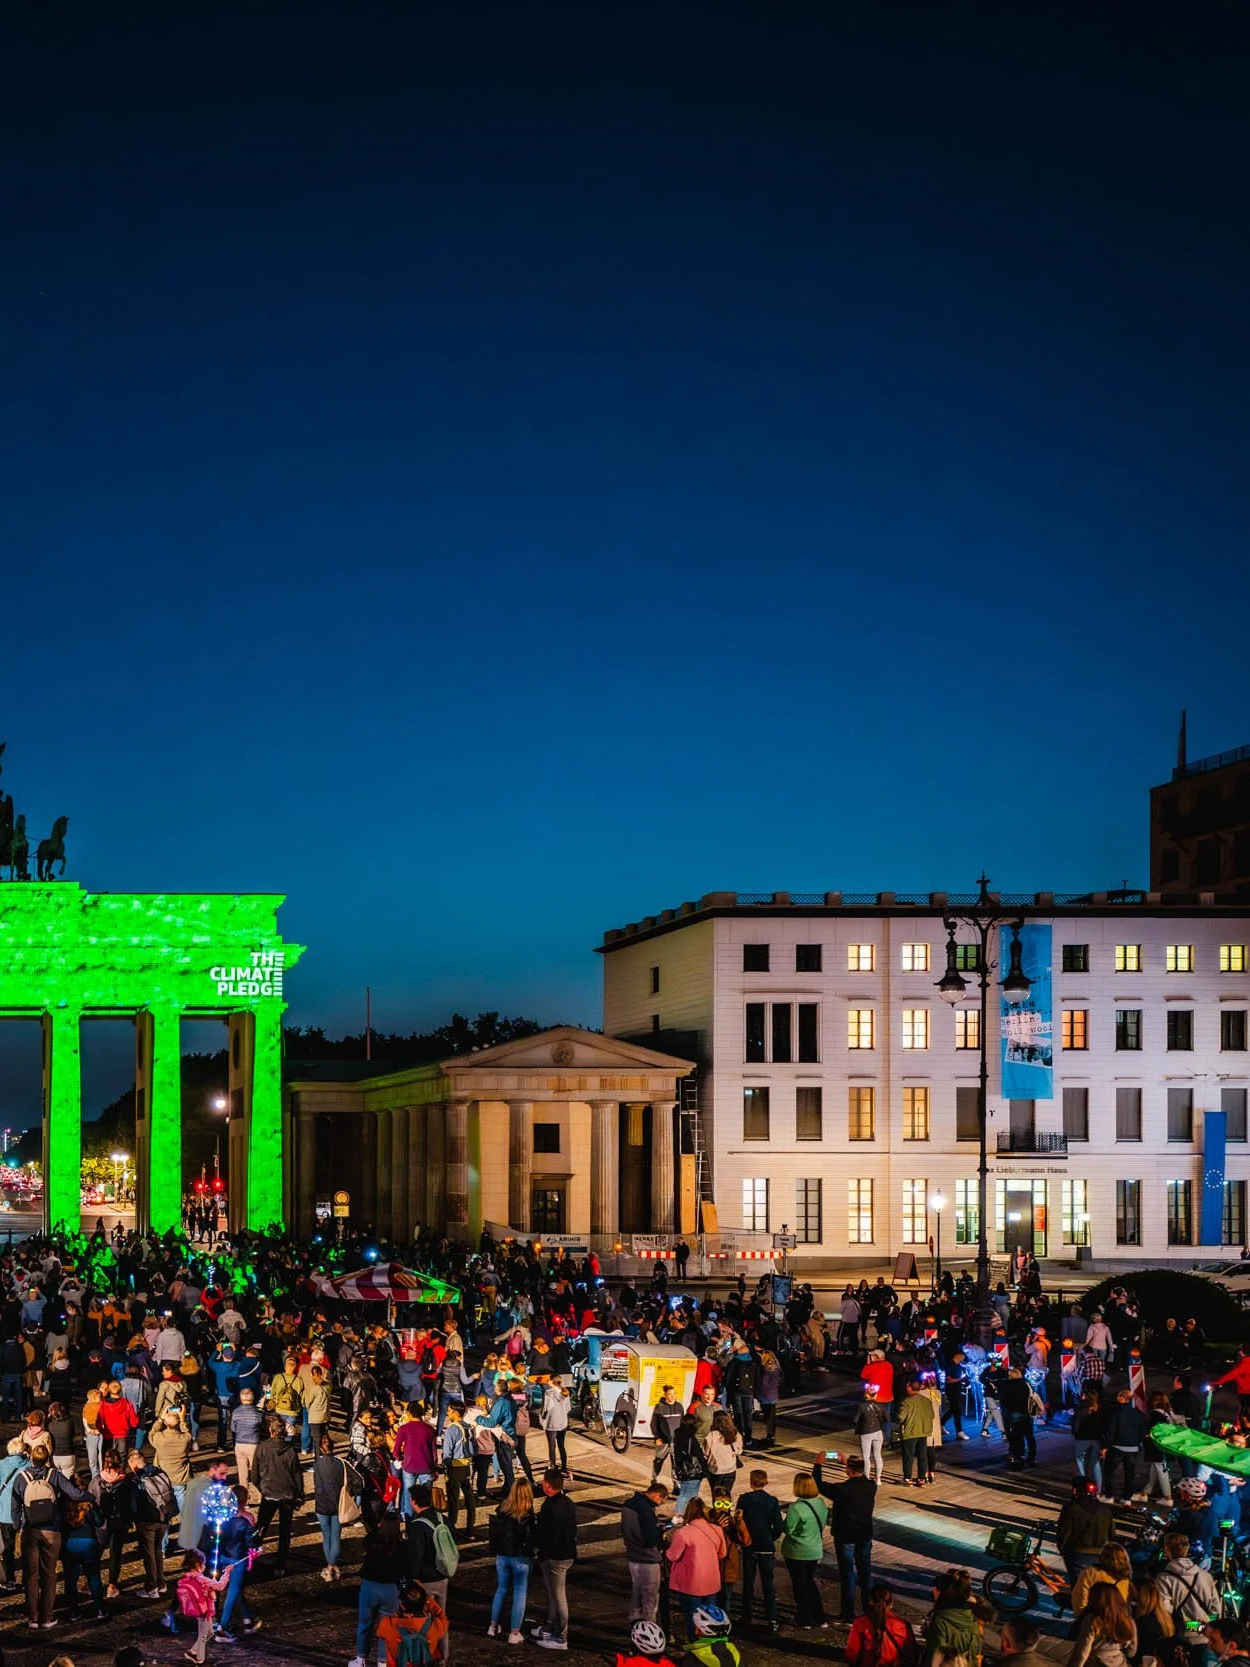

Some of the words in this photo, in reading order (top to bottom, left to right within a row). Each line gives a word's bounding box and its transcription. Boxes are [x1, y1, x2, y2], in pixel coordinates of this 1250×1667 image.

[250, 952, 285, 967] THE
[210, 966, 283, 981] CLIMATE
[217, 981, 283, 996] PLEDGE
